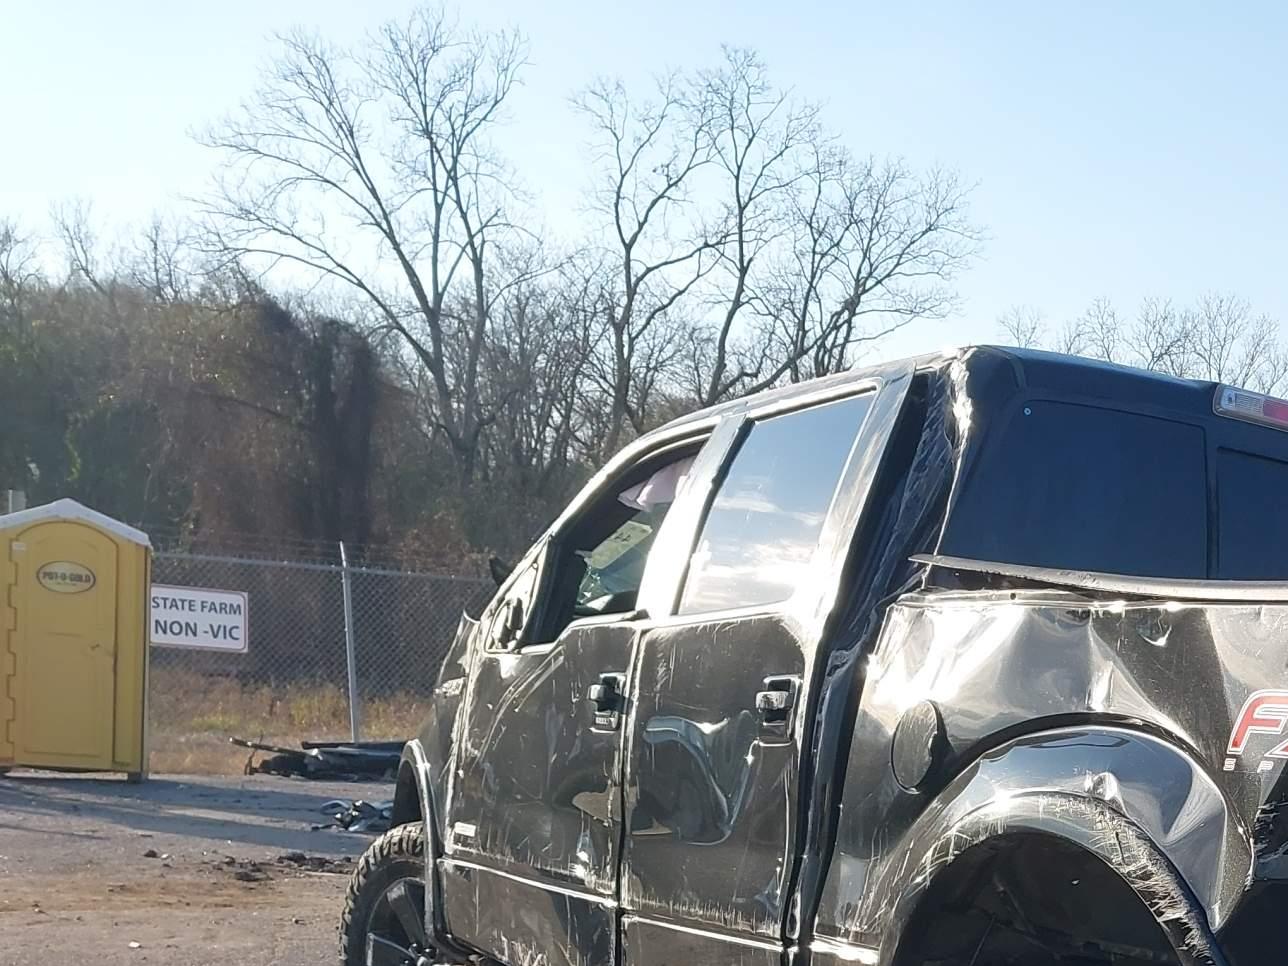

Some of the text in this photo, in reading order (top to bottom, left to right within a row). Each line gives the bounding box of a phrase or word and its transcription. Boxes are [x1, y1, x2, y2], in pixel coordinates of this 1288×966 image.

[151, 596, 242, 616] STATE FARM
[154, 619, 241, 641] NON -VIC
